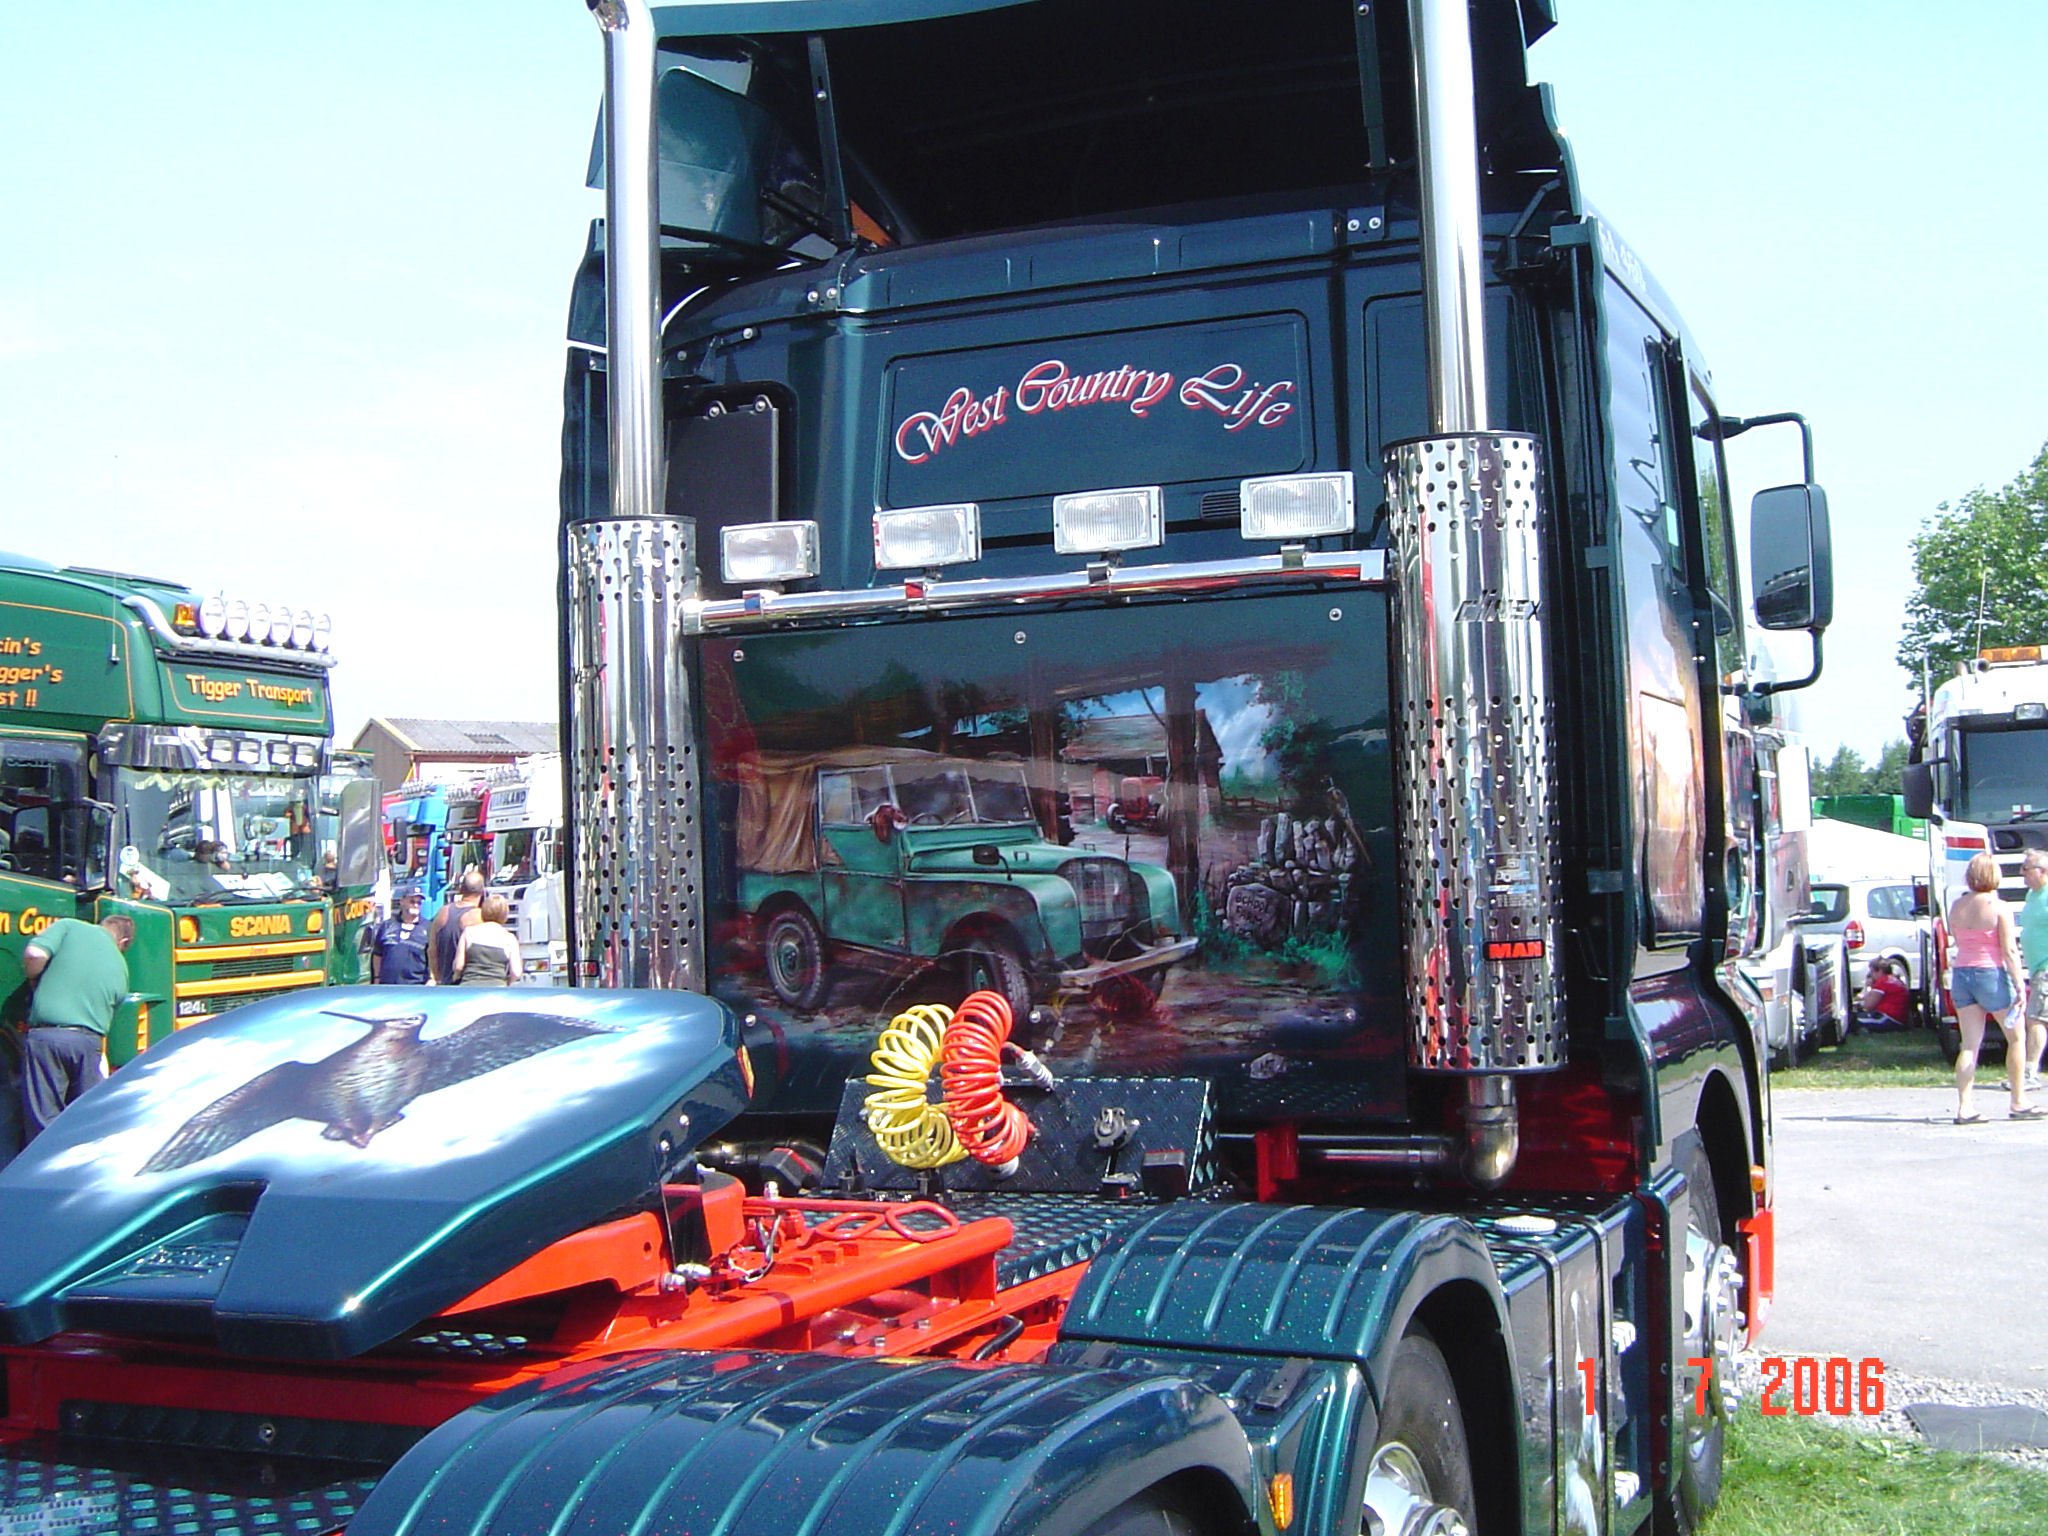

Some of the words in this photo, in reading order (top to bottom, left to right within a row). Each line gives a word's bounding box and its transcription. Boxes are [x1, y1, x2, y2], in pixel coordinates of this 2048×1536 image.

[895, 386, 1009, 464] West
[1015, 359, 1175, 418] Country
[1179, 363, 1297, 432] Life
[185, 673, 242, 703] Tigger
[245, 678, 313, 708] Transport
[230, 914, 292, 938] SCANIA
[1489, 940, 1543, 959] MAN
